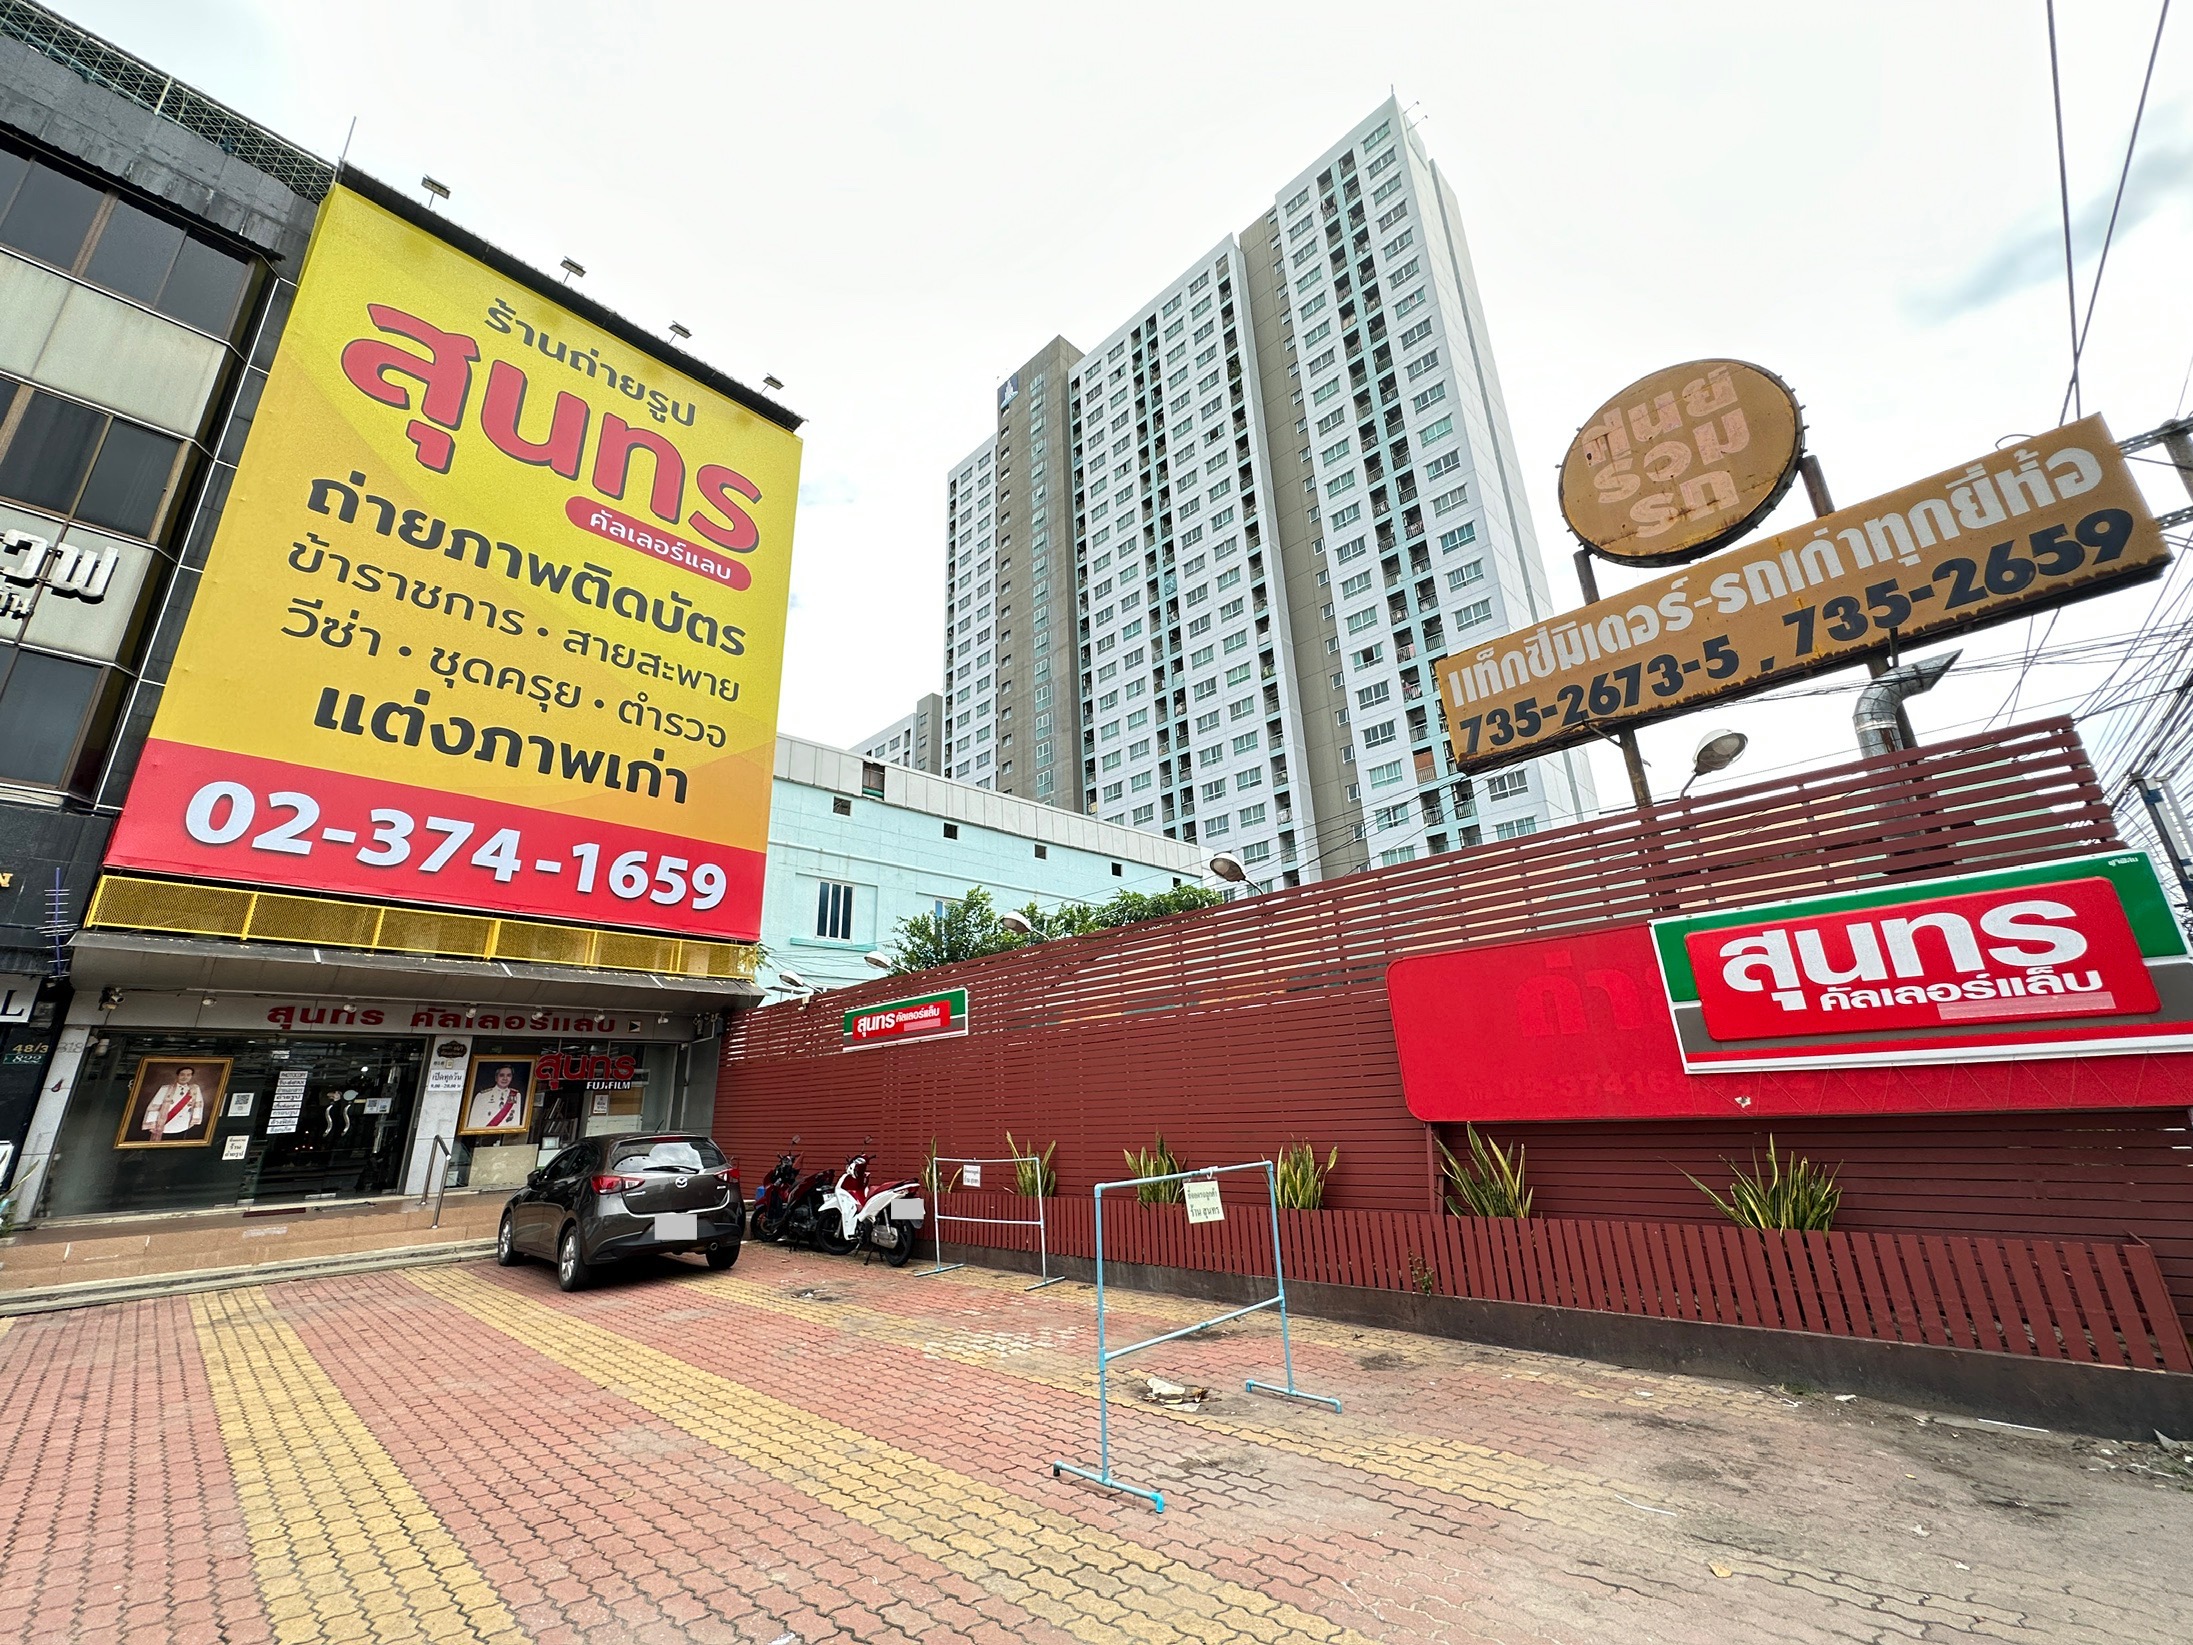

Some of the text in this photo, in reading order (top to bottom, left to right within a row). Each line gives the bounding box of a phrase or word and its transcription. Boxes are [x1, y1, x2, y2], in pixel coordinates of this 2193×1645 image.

[484, 298, 696, 427] ร้านถ่ายรูป
[341, 303, 762, 554] สุนทร
[589, 509, 731, 580] คัลเลอร์แลบ
[1629, 470, 1740, 538] รถ
[287, 531, 740, 702] ข้าราชการ สายสะพาย
[307, 471, 748, 655] ถ่ายภาพติดบัตร
[280, 597, 727, 748] วีซ่า ชุดครุย ตำรวจ
[1460, 634, 1740, 755] 735-2673-5
[1781, 508, 2134, 657] 735-2659
[314, 687, 689, 804] แต่งภาพเก่า
[184, 780, 728, 911] 02-374-1659
[1719, 900, 2089, 1011] สุนทร
[1820, 965, 2104, 1012] คัลเลอร์แล็บ
[12, 1042, 50, 1054] 48/3
[267, 1004, 385, 1030] สุนทร
[535, 1052, 637, 1090] สุนทร
[857, 1012, 896, 1038] สุนทร
